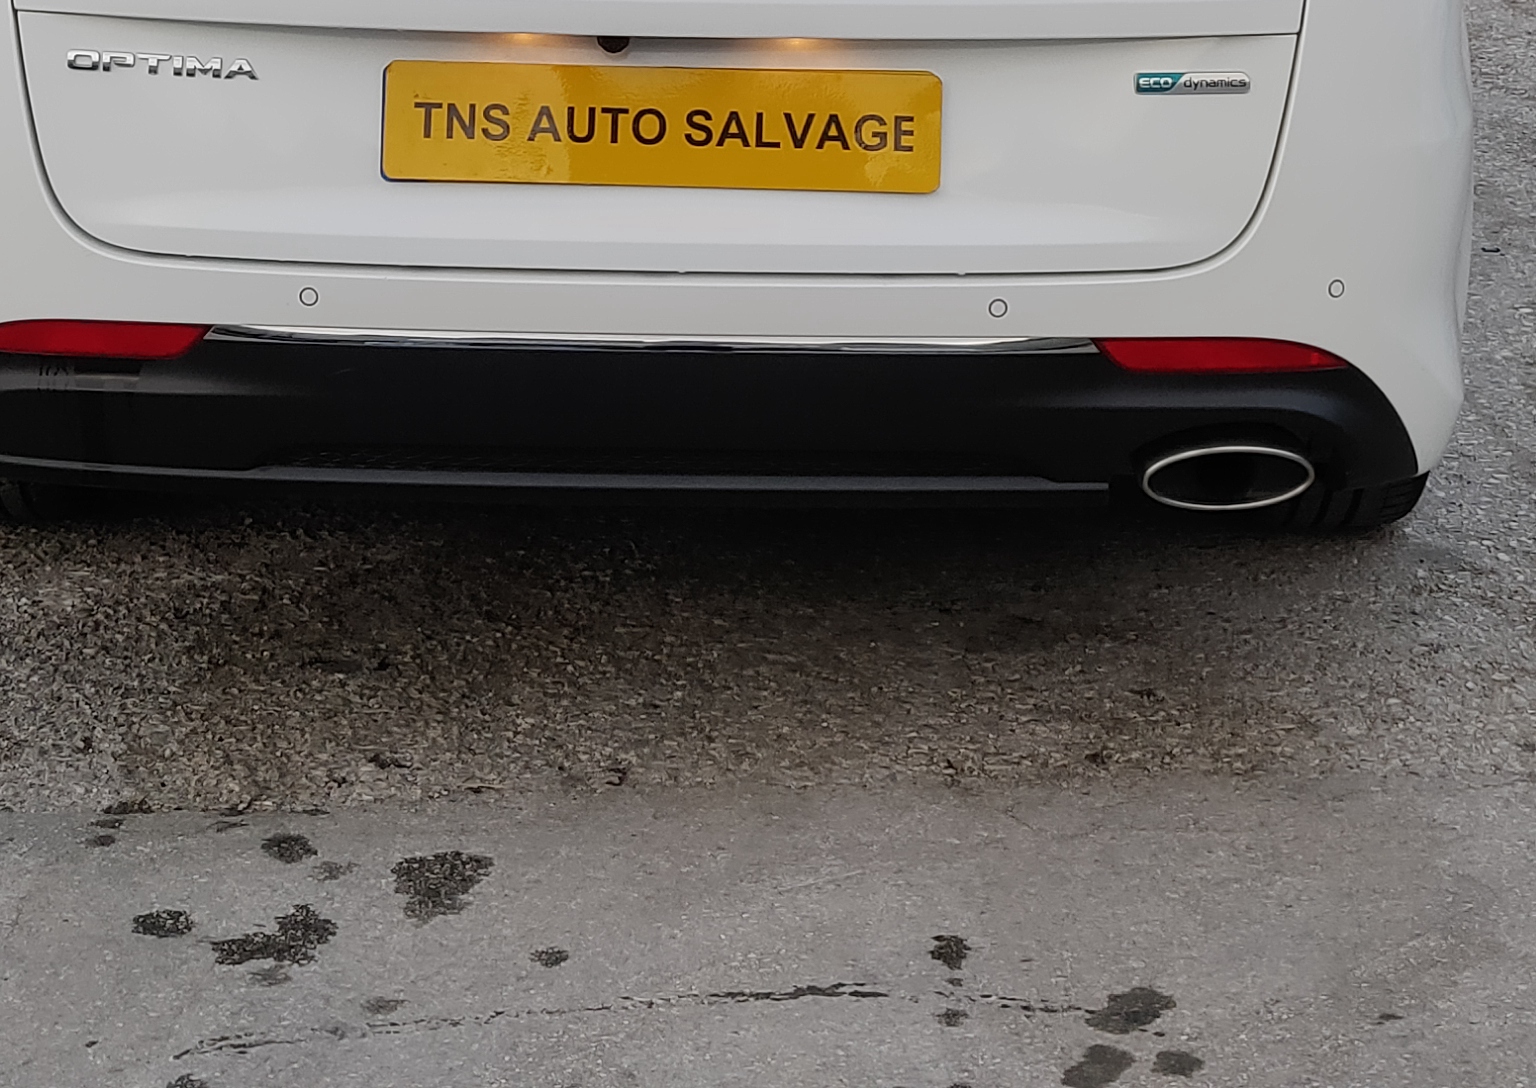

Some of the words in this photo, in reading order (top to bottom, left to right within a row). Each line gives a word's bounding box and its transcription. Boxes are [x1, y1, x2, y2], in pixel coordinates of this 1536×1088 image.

[67, 48, 259, 80] OPTIMA
[1138, 77, 1173, 89] ECO
[1183, 76, 1247, 91] dynamics
[414, 101, 511, 142] TNS
[526, 105, 667, 146] AUTO
[683, 108, 915, 153] SALVAGE
